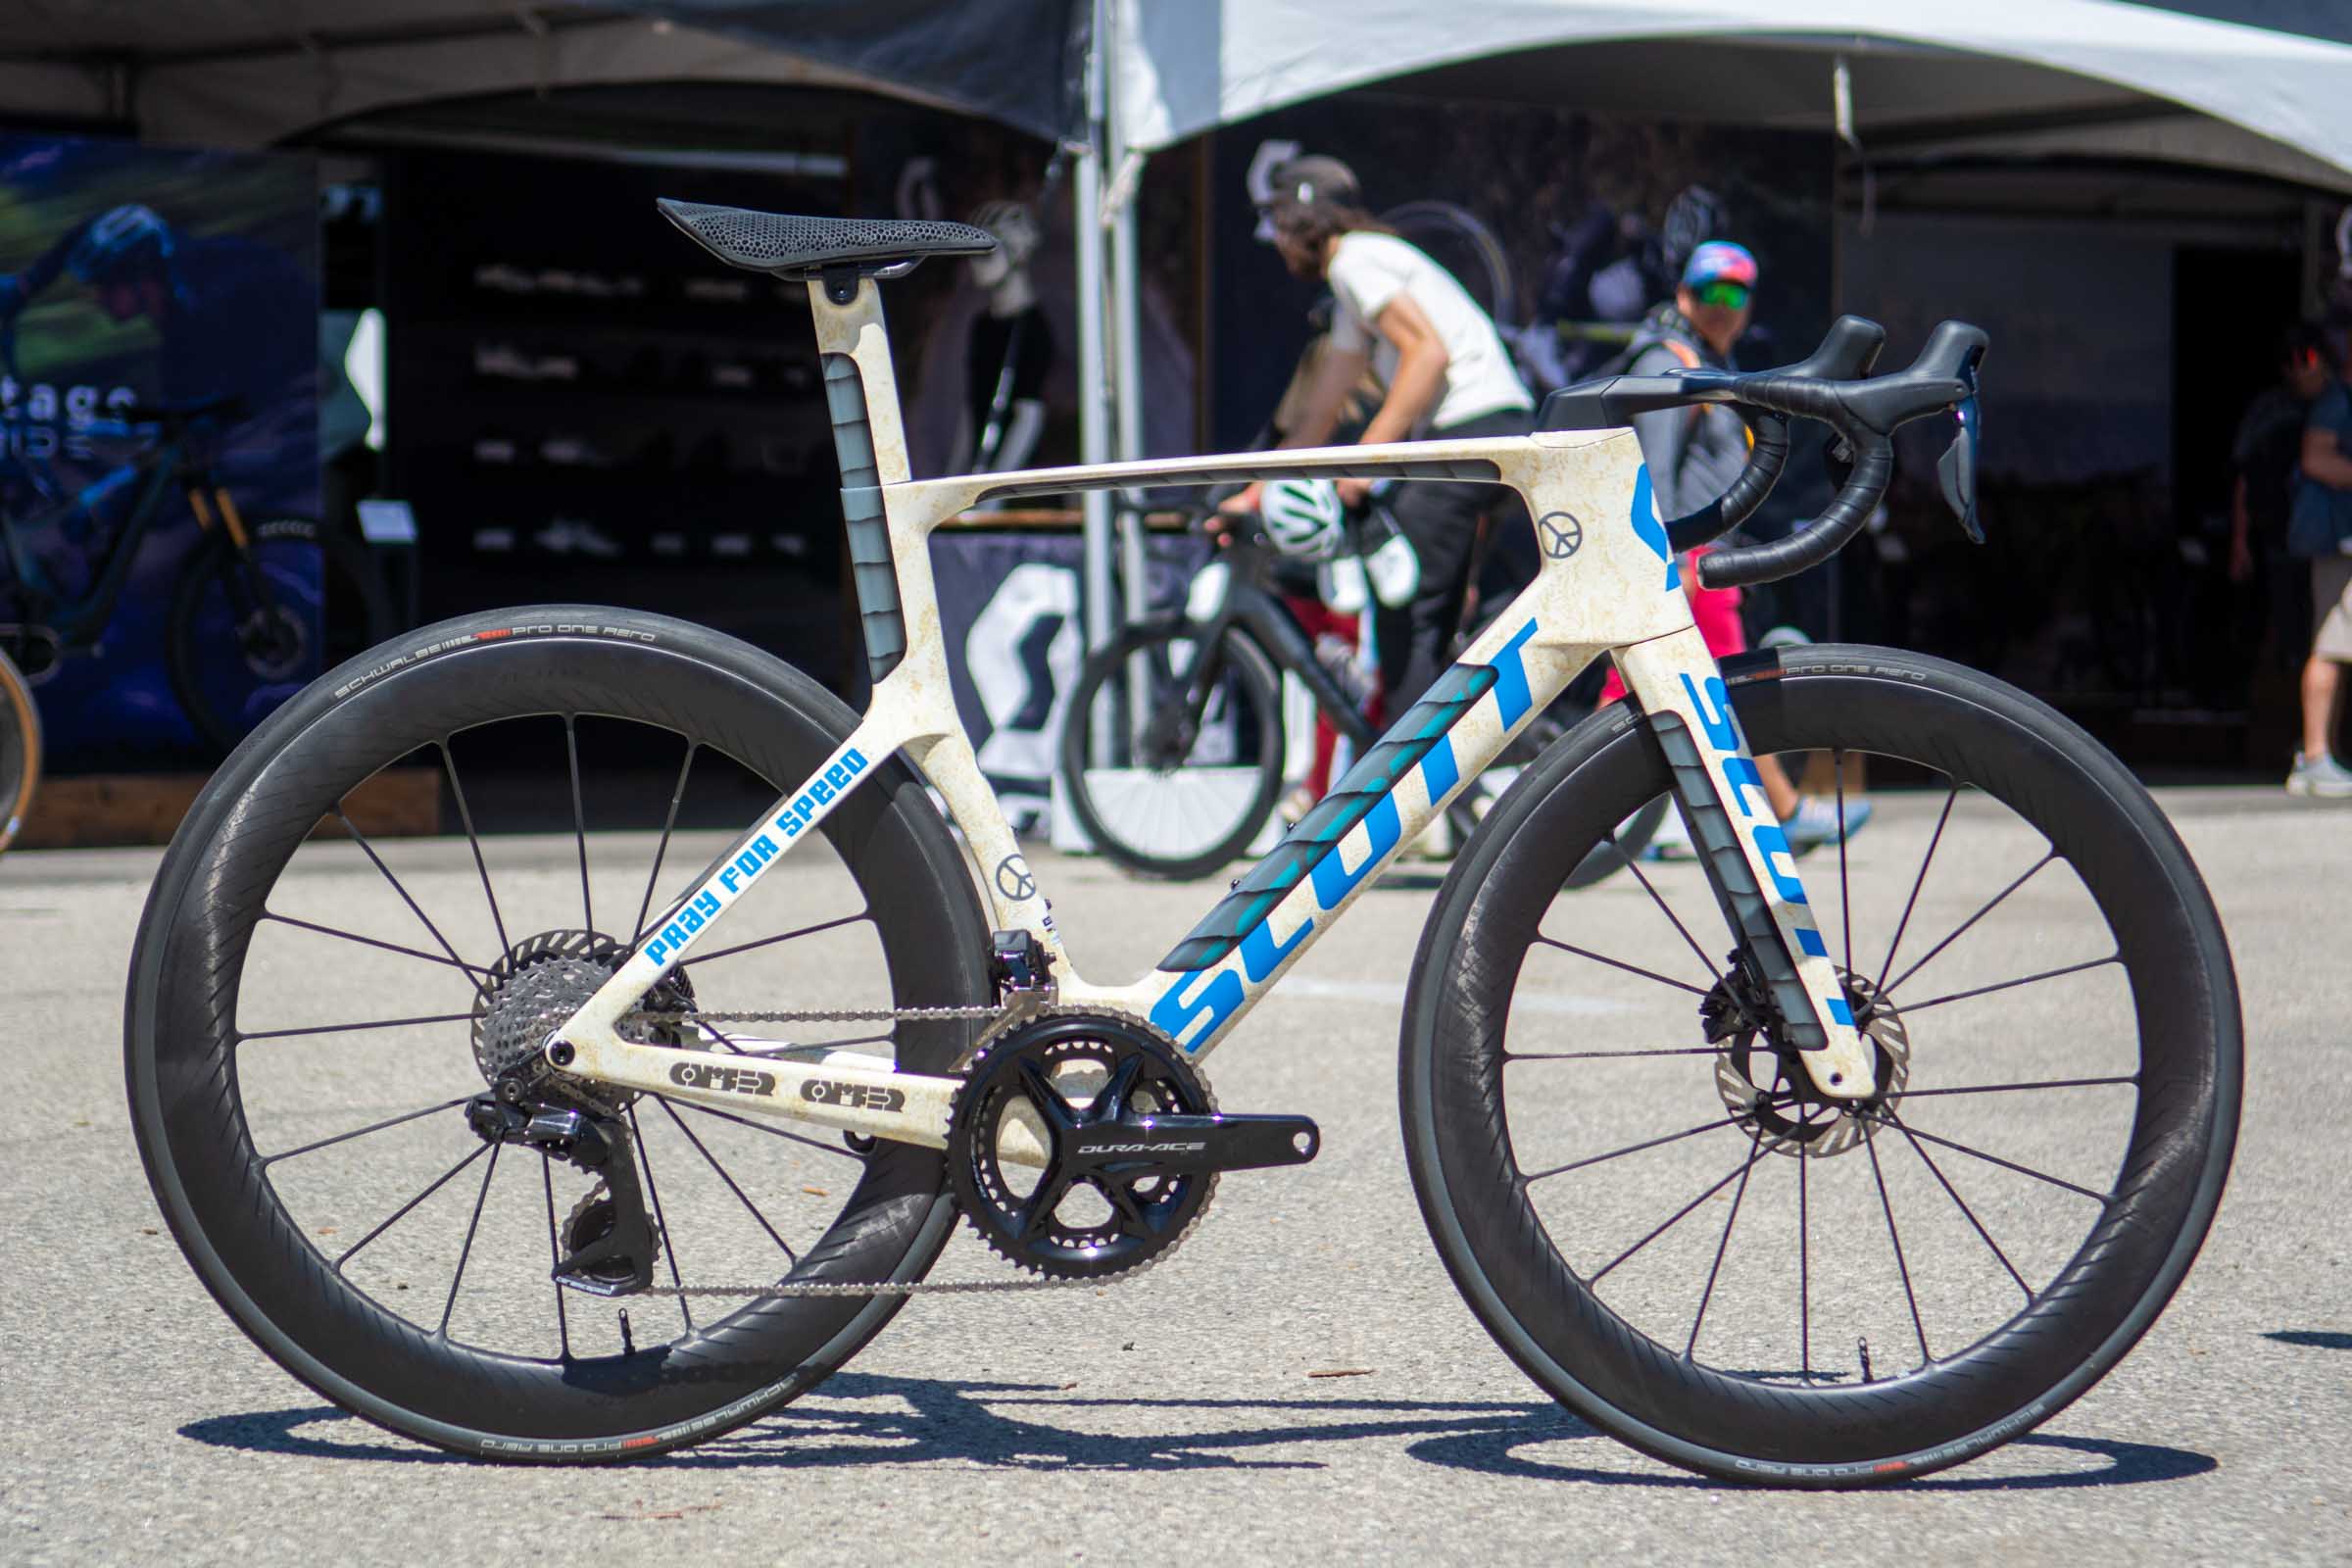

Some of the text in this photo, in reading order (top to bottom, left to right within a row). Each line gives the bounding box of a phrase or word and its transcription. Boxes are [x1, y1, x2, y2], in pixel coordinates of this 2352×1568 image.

[334, 624, 656, 699] SCHWALBE PRO ONE AERO
[1830, 663, 1871, 675] ONE
[1875, 666, 1927, 682] AERO
[644, 748, 869, 966] PRAY FOR SPEED
[1078, 1142, 1207, 1154] DURA-ACE
[538, 1444, 578, 1453] ONE
[582, 1441, 622, 1453] PRO
